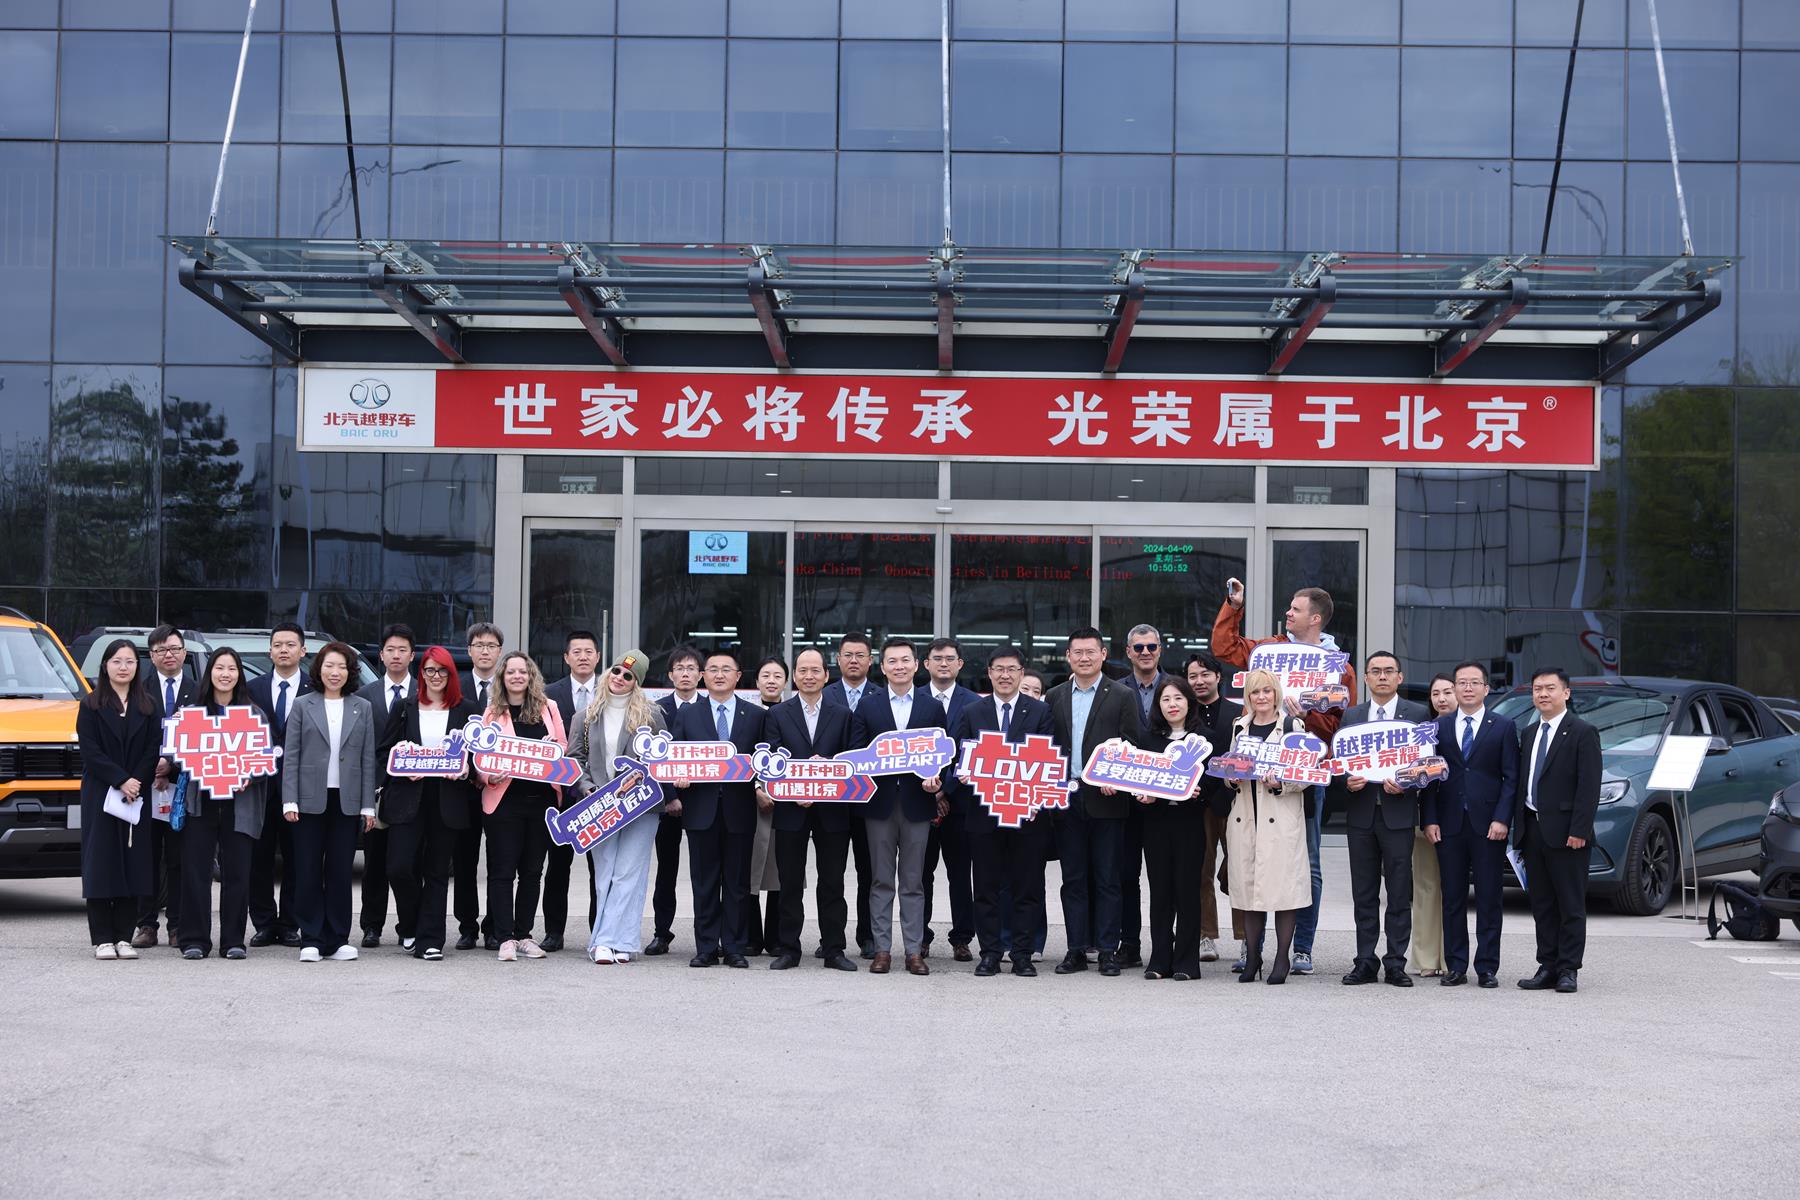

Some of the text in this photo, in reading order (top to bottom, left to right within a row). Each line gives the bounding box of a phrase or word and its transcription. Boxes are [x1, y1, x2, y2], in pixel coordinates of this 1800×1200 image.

[323, 412, 416, 427] 北汽越野车
[494, 383, 973, 444] 世家必将传承
[340, 429, 369, 438] BAIC
[1143, 544, 1194, 553] 2024-04-09
[1154, 553, 1183, 563] 星期二
[1148, 563, 1189, 572] 10:50:52
[1250, 652, 1347, 673] 越野世家
[162, 719, 265, 754] I LOVE
[877, 736, 937, 757] 北京
[1335, 723, 1437, 758] 越野世家
[499, 739, 556, 759] 打卡中国
[672, 745, 729, 759] 打卡中国
[1236, 735, 1319, 768] 荣耀时刻
[202, 753, 277, 777] 北京
[393, 758, 462, 770] 享受越野生活
[480, 755, 545, 777] 机遇北京
[656, 763, 721, 778] 机遇北京
[790, 763, 847, 777] 打卡中国
[857, 752, 947, 772] MY HEART
[956, 741, 1062, 783] I LOVE
[1092, 760, 1191, 792] 享受越野生活
[773, 782, 839, 797] 机遇北京
[993, 781, 1069, 808] 北京
[566, 791, 616, 833] 中国质造
[576, 784, 654, 849] 北京 匠心
